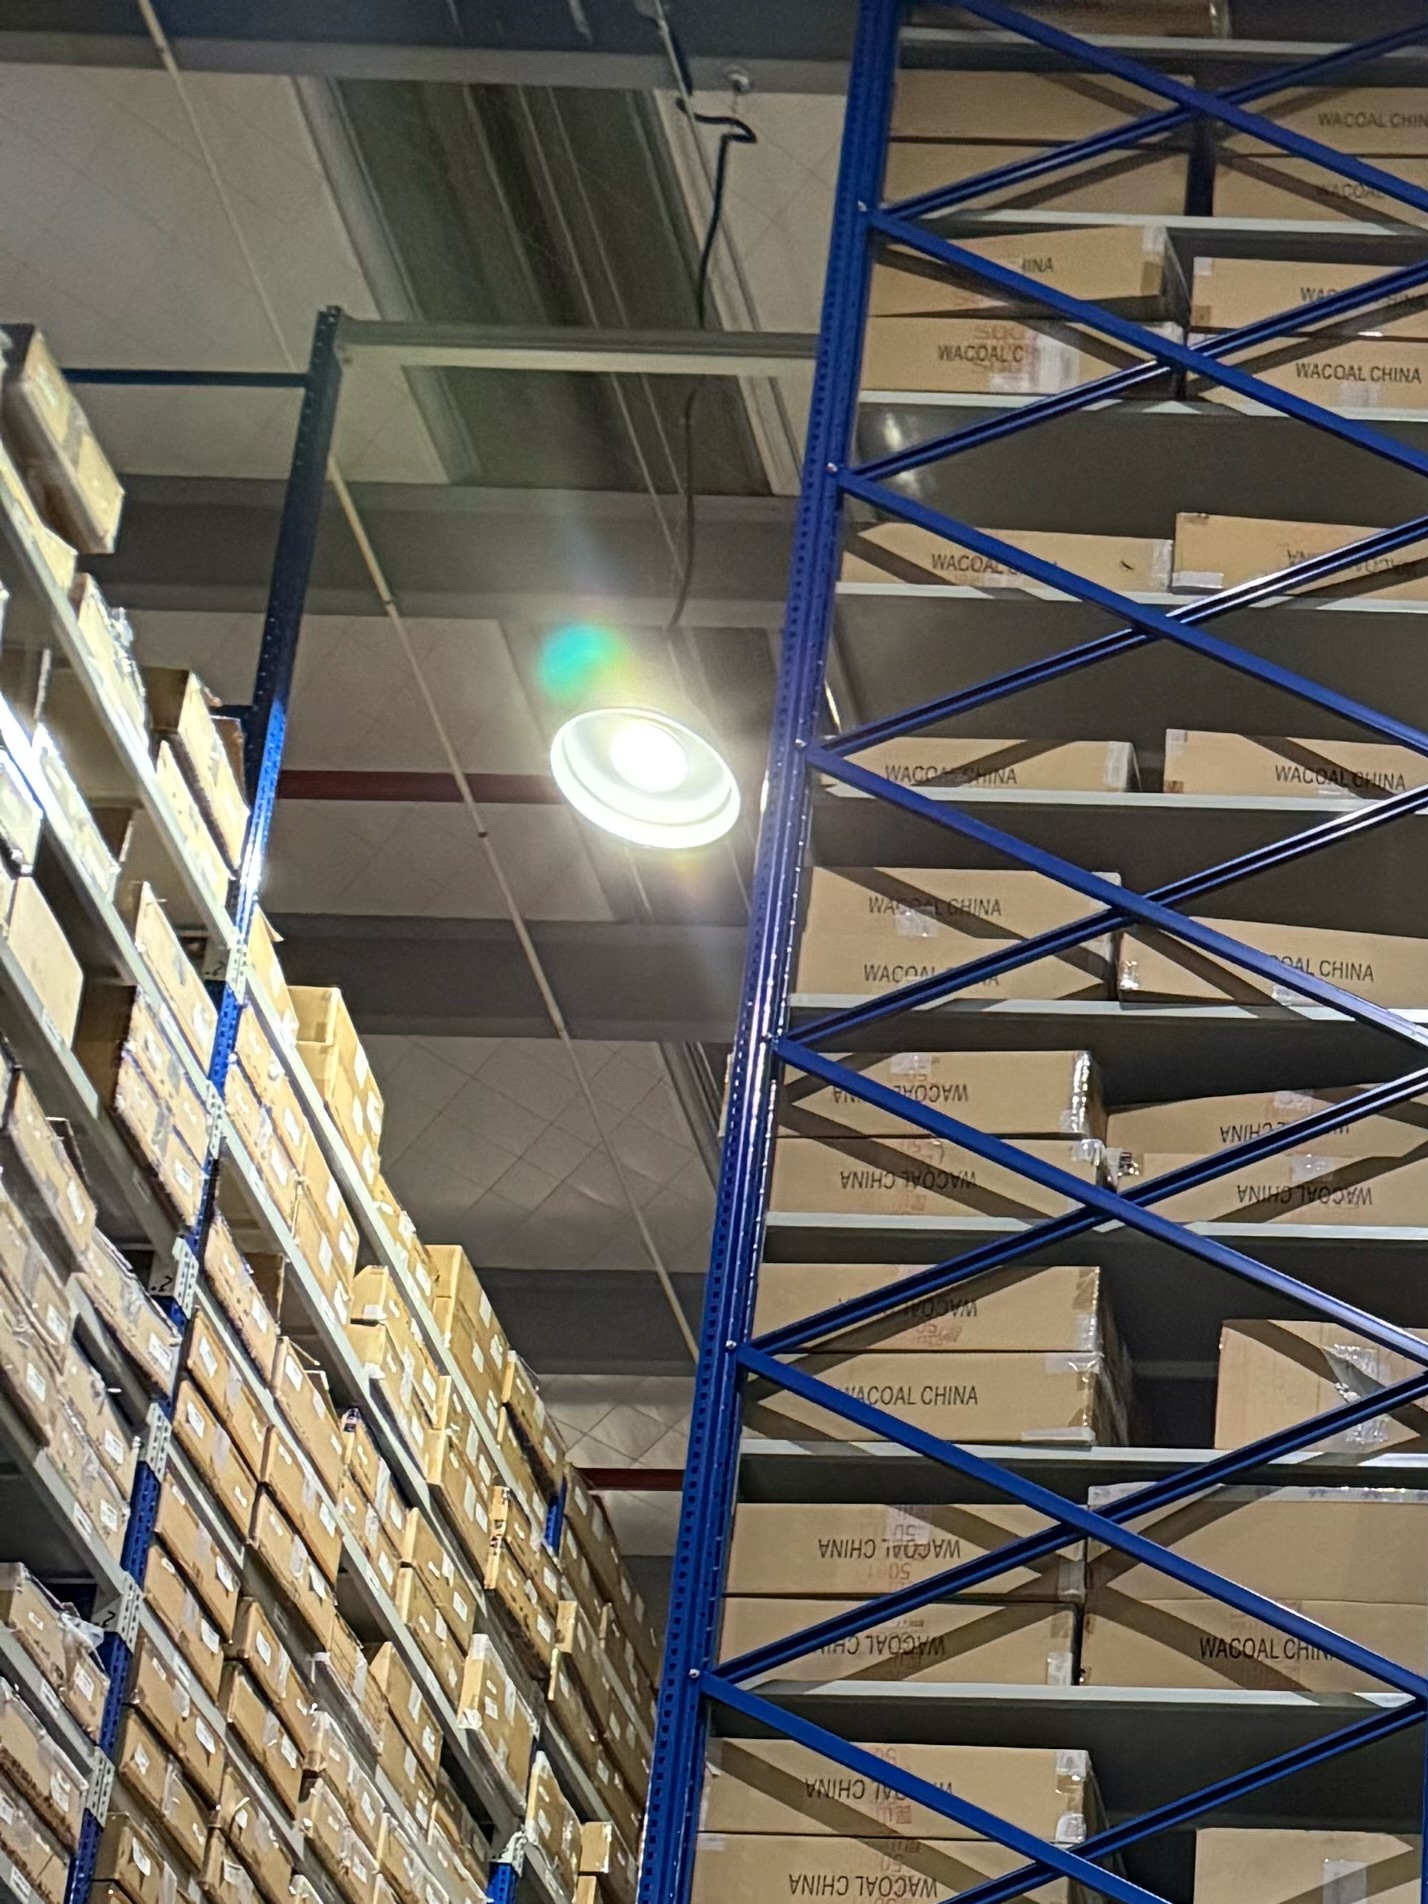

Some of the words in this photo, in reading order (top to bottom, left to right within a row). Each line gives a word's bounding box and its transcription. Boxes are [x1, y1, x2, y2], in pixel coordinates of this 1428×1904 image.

[1318, 111, 1389, 128] WACOAL
[1296, 363, 1366, 383] WACOAL
[1369, 365, 1423, 385] CHINA
[1275, 765, 1349, 785] WACOAL
[949, 898, 1001, 917] CHINA
[1319, 960, 1374, 982] CHINA
[840, 1170, 900, 1191] CHINA
[1236, 1183, 1293, 1205] CHINA
[1297, 1183, 1373, 1205] WACOAL
[920, 1386, 978, 1406] CHINA
[818, 1538, 874, 1560] CHINA
[867, 1634, 945, 1656] WACOAL
[1200, 1637, 1279, 1660] WACOAL
[805, 1779, 866, 1800] CHINA
[788, 1873, 849, 1897] CHINA
[851, 1873, 938, 1897] WACOAL
